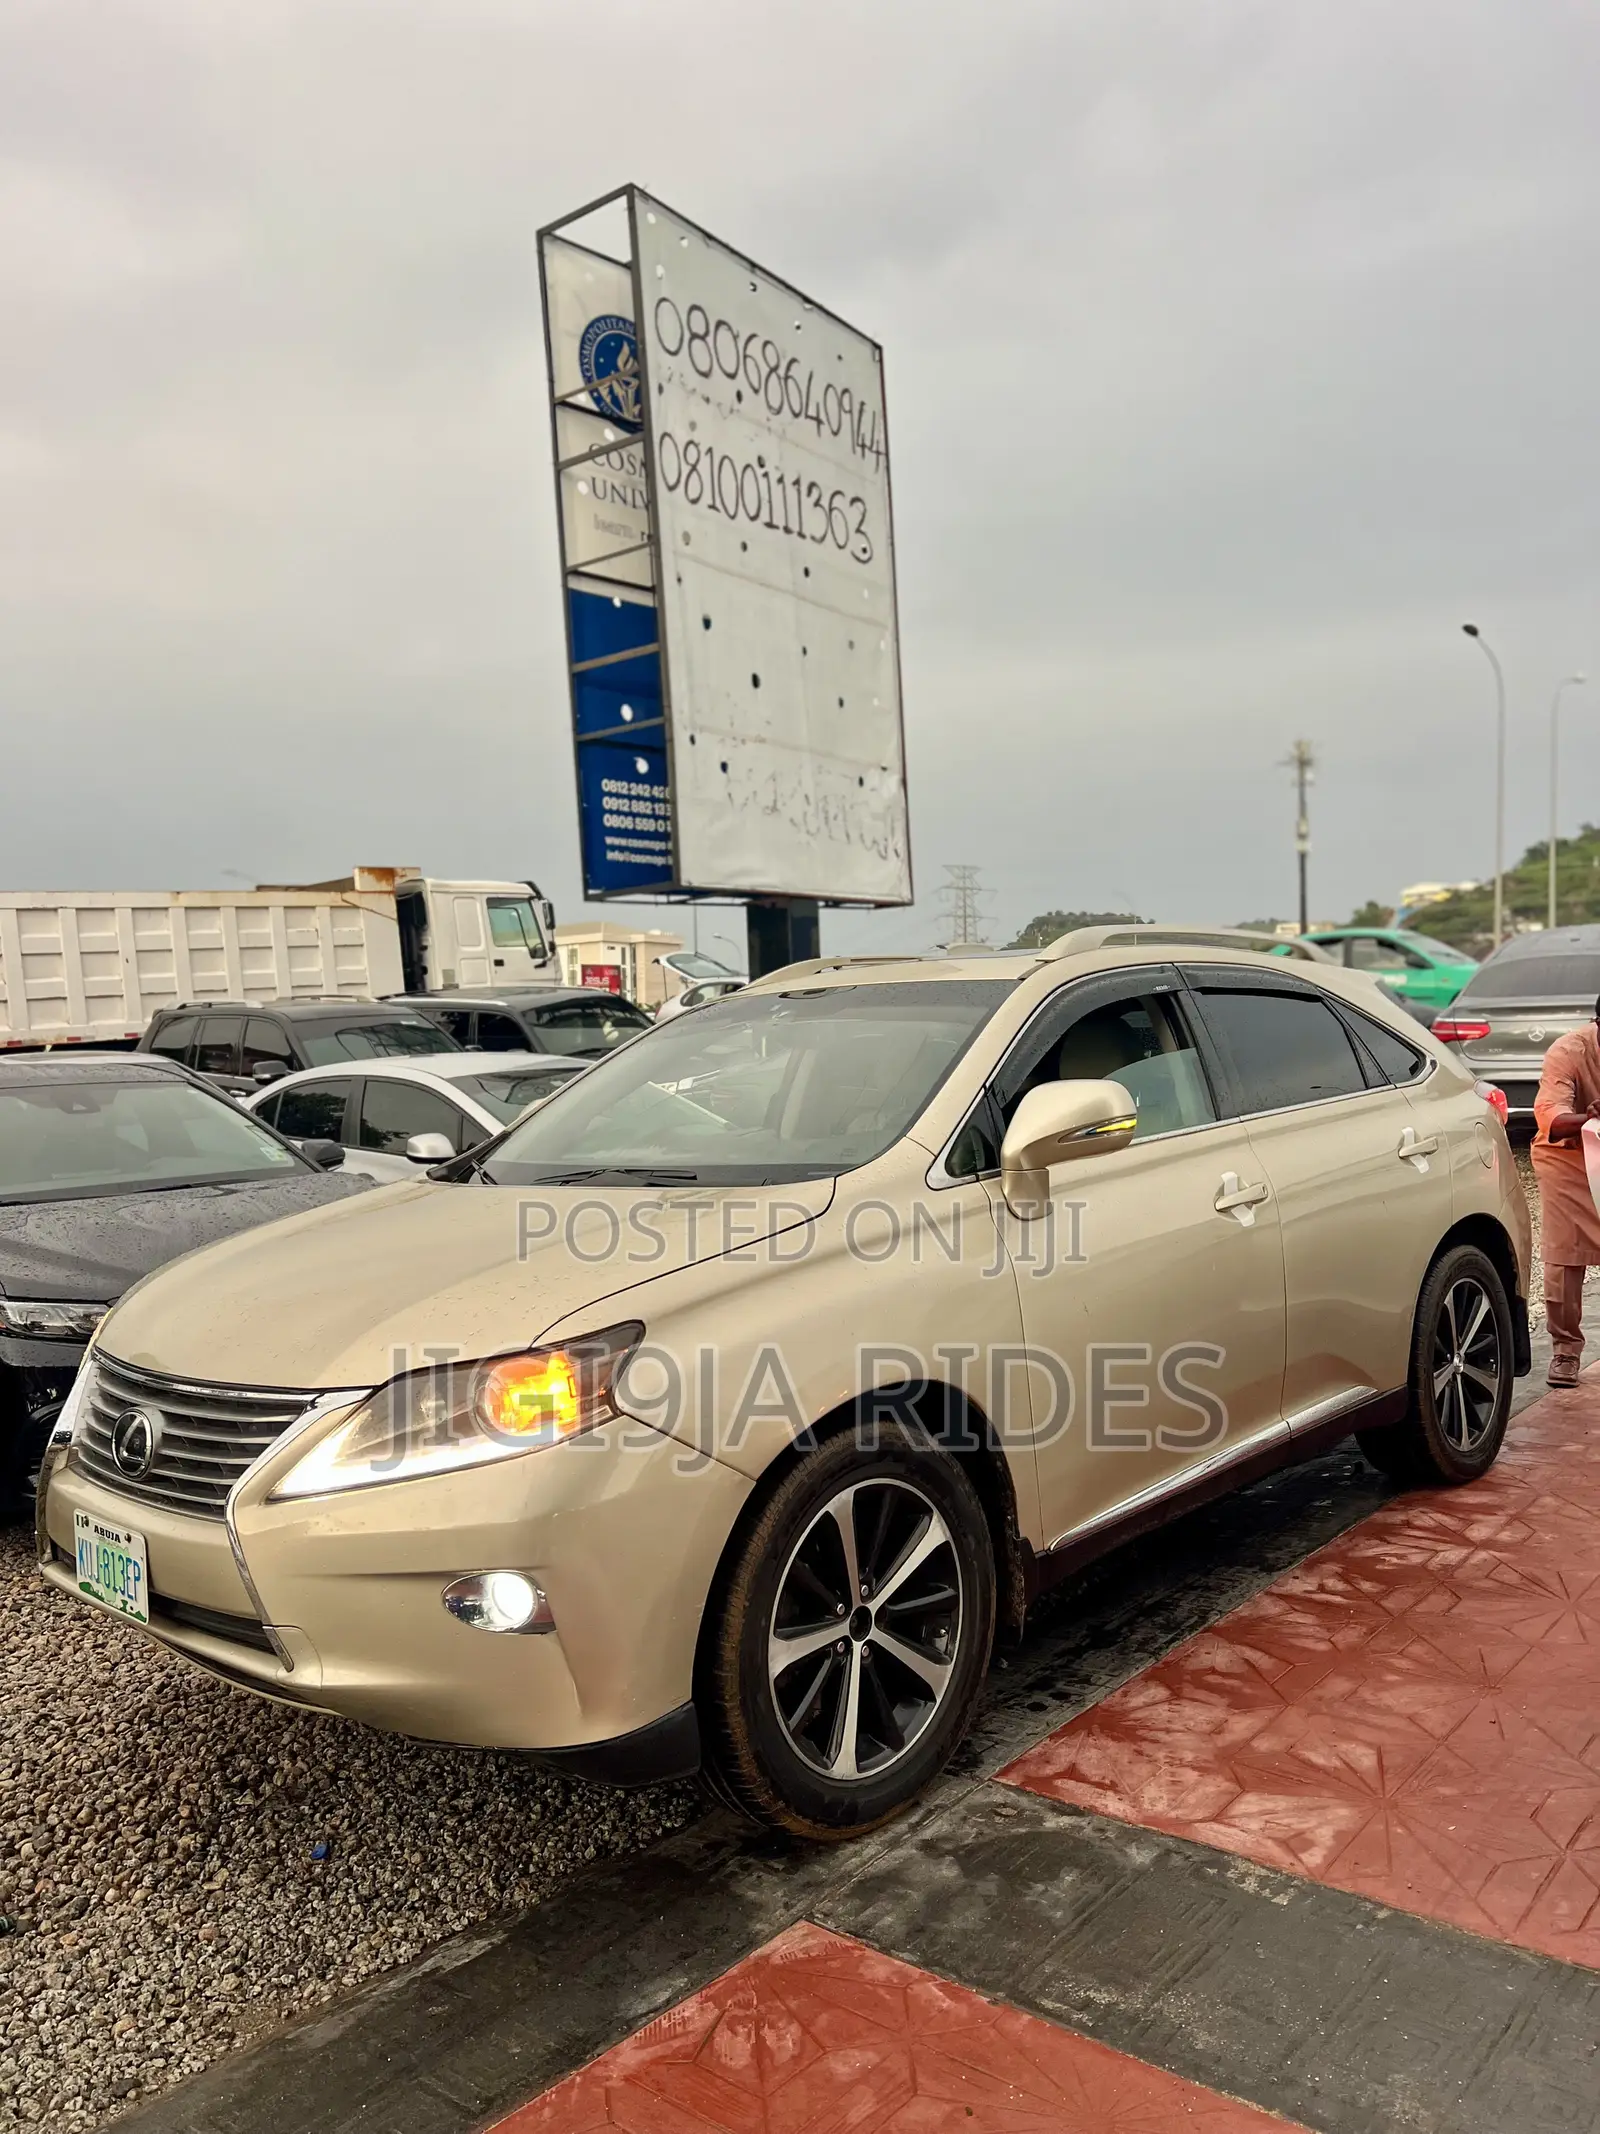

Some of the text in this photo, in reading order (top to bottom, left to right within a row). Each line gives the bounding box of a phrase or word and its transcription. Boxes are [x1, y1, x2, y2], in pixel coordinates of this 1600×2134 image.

[655, 297, 889, 474] 08068640944
[659, 431, 873, 564] 08100111363
[77, 1536, 141, 1602] KUJ-813EP
[93, 1524, 121, 1543] ABUJA
